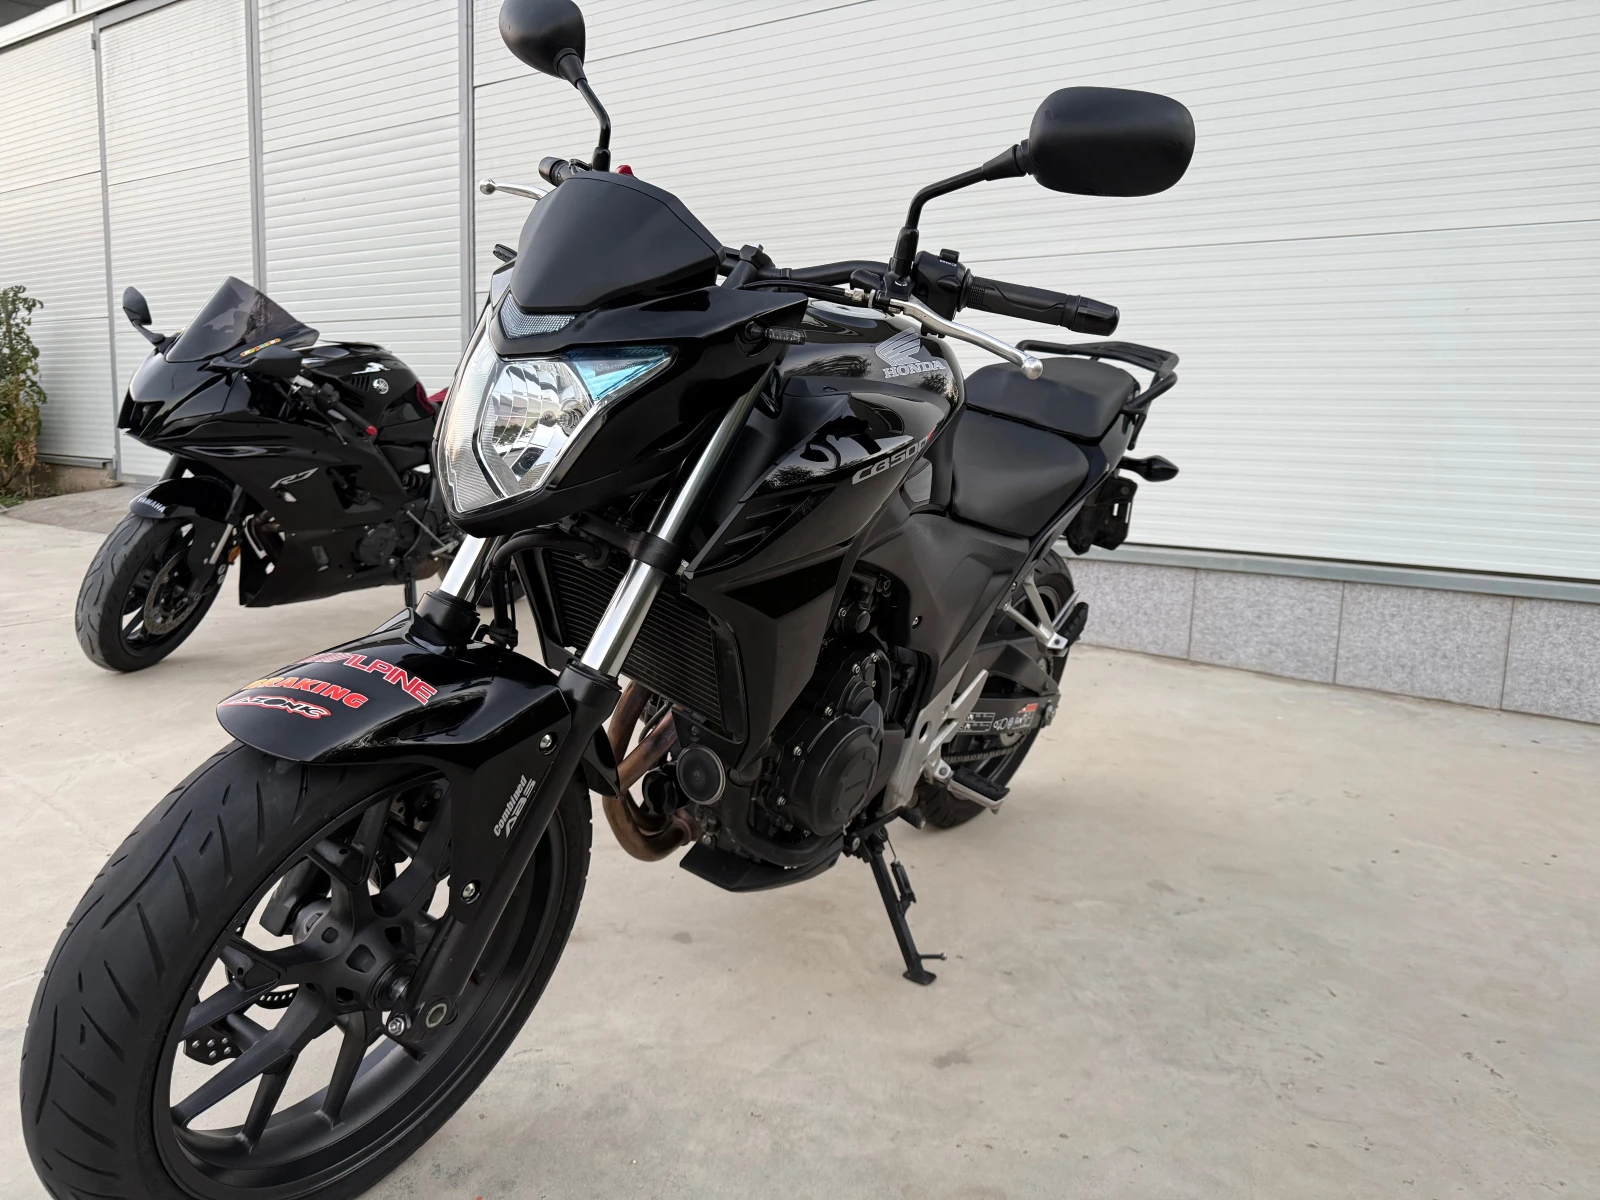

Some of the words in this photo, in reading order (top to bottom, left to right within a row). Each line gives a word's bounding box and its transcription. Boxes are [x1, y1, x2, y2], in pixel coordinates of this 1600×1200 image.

[882, 360, 946, 379] HONDA
[137, 496, 166, 513] YAMAHA
[241, 676, 369, 709] BRAKING
[494, 774, 527, 837] Combined
[506, 778, 536, 839] ABS
